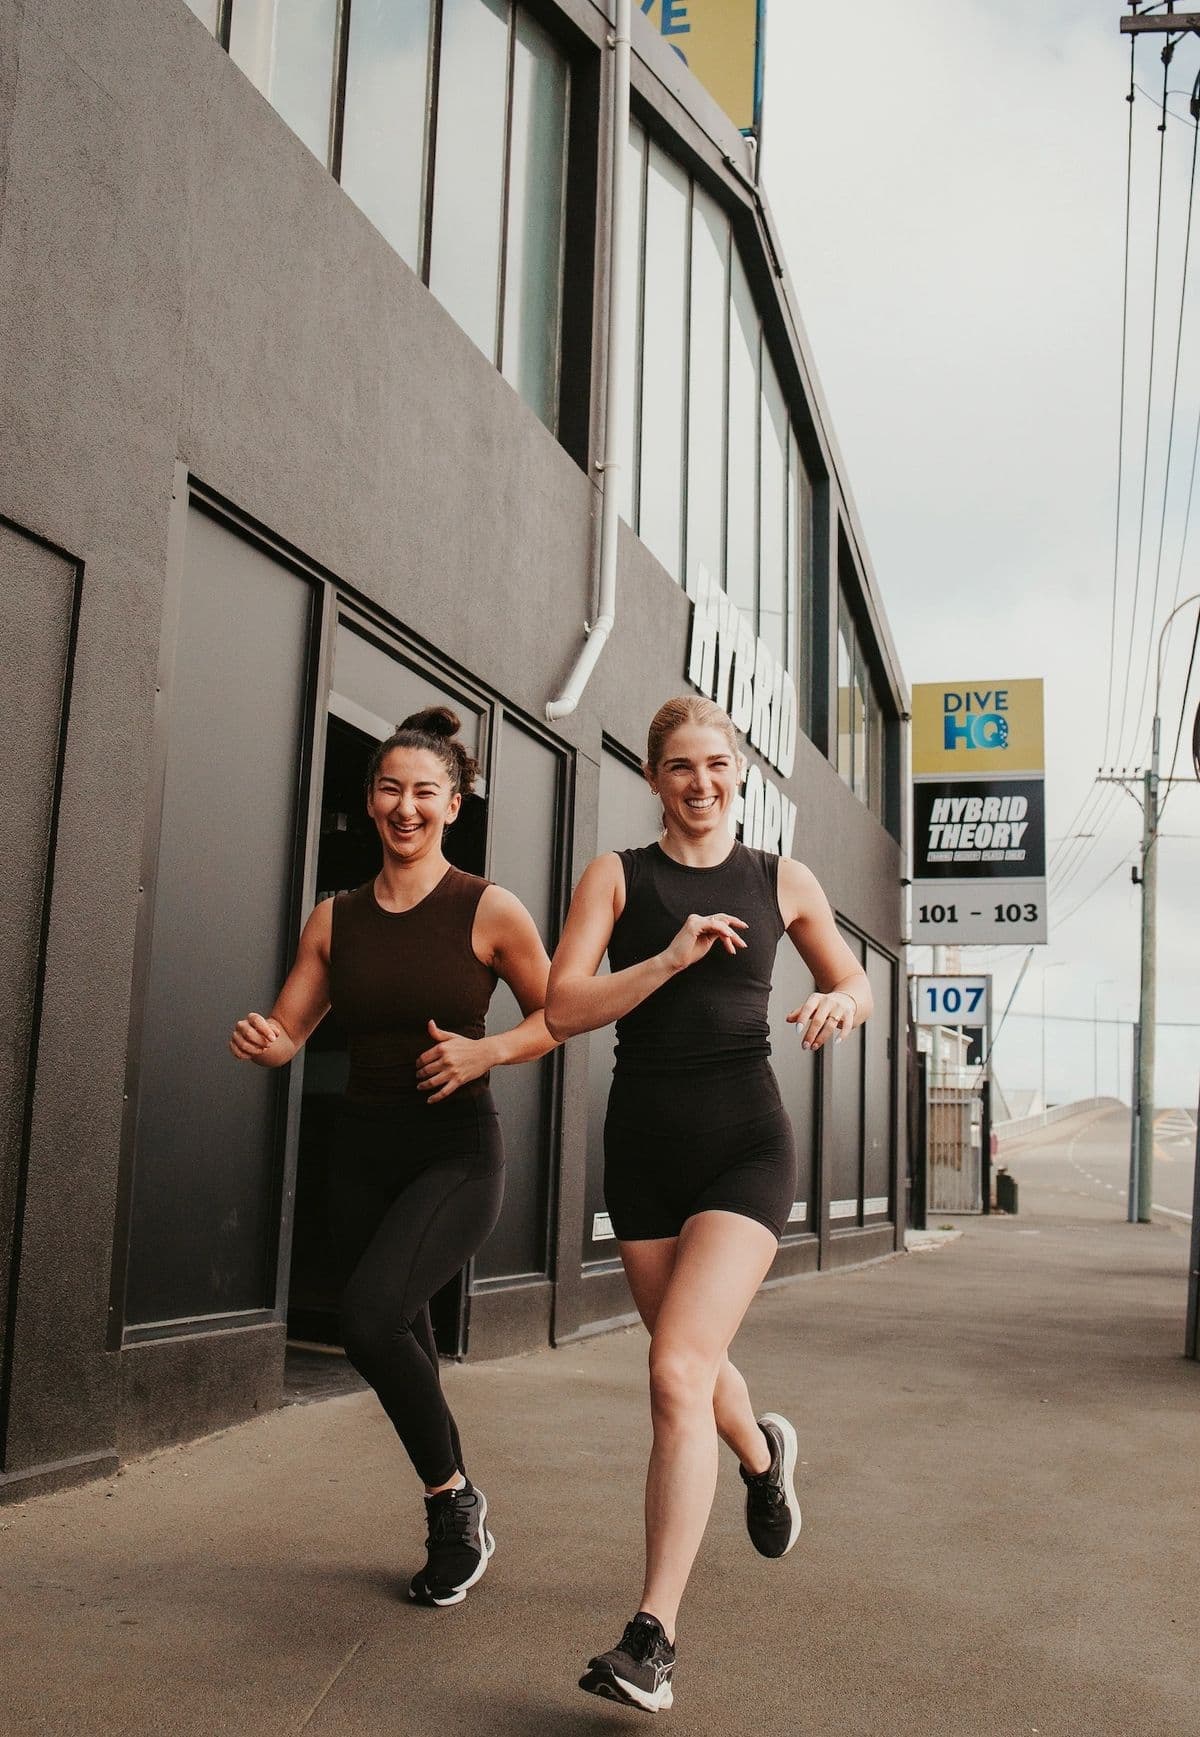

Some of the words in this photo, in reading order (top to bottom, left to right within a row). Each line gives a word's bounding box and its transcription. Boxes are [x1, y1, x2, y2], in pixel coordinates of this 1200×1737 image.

[944, 691, 1008, 712] DIVE
[944, 714, 1009, 750] HQ
[931, 796, 1028, 823] HYBRID
[928, 822, 1029, 849] THEORY
[919, 904, 958, 923] 101
[994, 903, 1038, 922] 103
[927, 987, 985, 1013] 107
